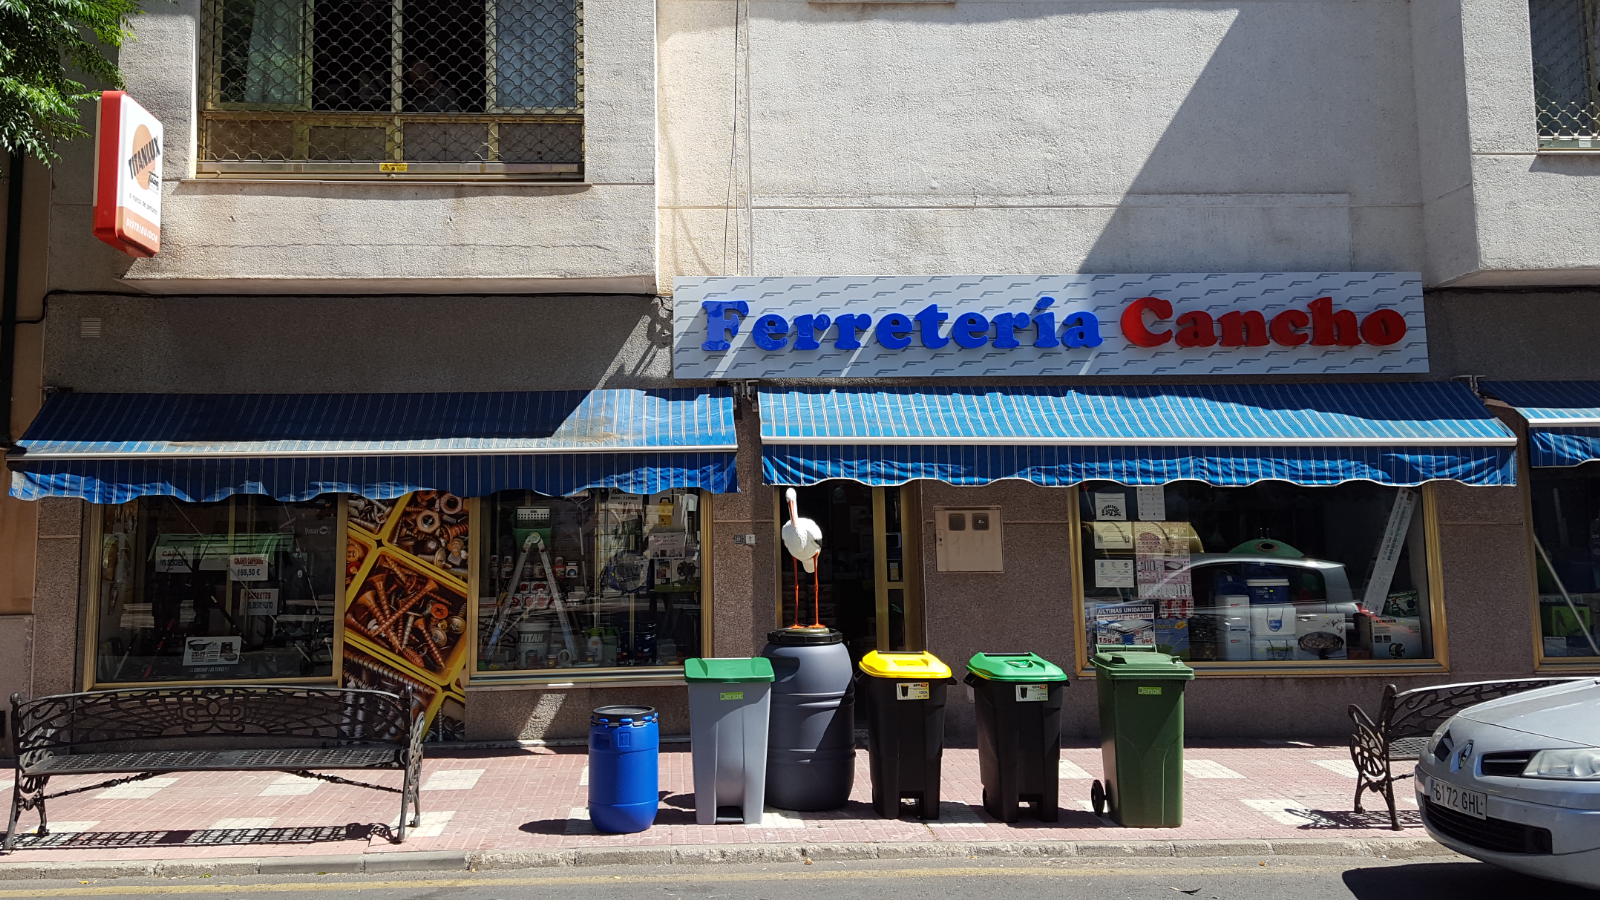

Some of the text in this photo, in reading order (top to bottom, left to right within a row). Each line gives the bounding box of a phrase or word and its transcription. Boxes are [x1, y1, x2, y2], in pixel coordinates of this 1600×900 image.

[128, 136, 160, 180] TITANLUX
[126, 217, 158, 243] DISTRIBUIDOR
[700, 296, 1407, 351] Ferretería Cancho
[520, 633, 544, 643] TITAN
[1138, 686, 1162, 695] Denox
[1435, 783, 1483, 816] 6172 GHL
